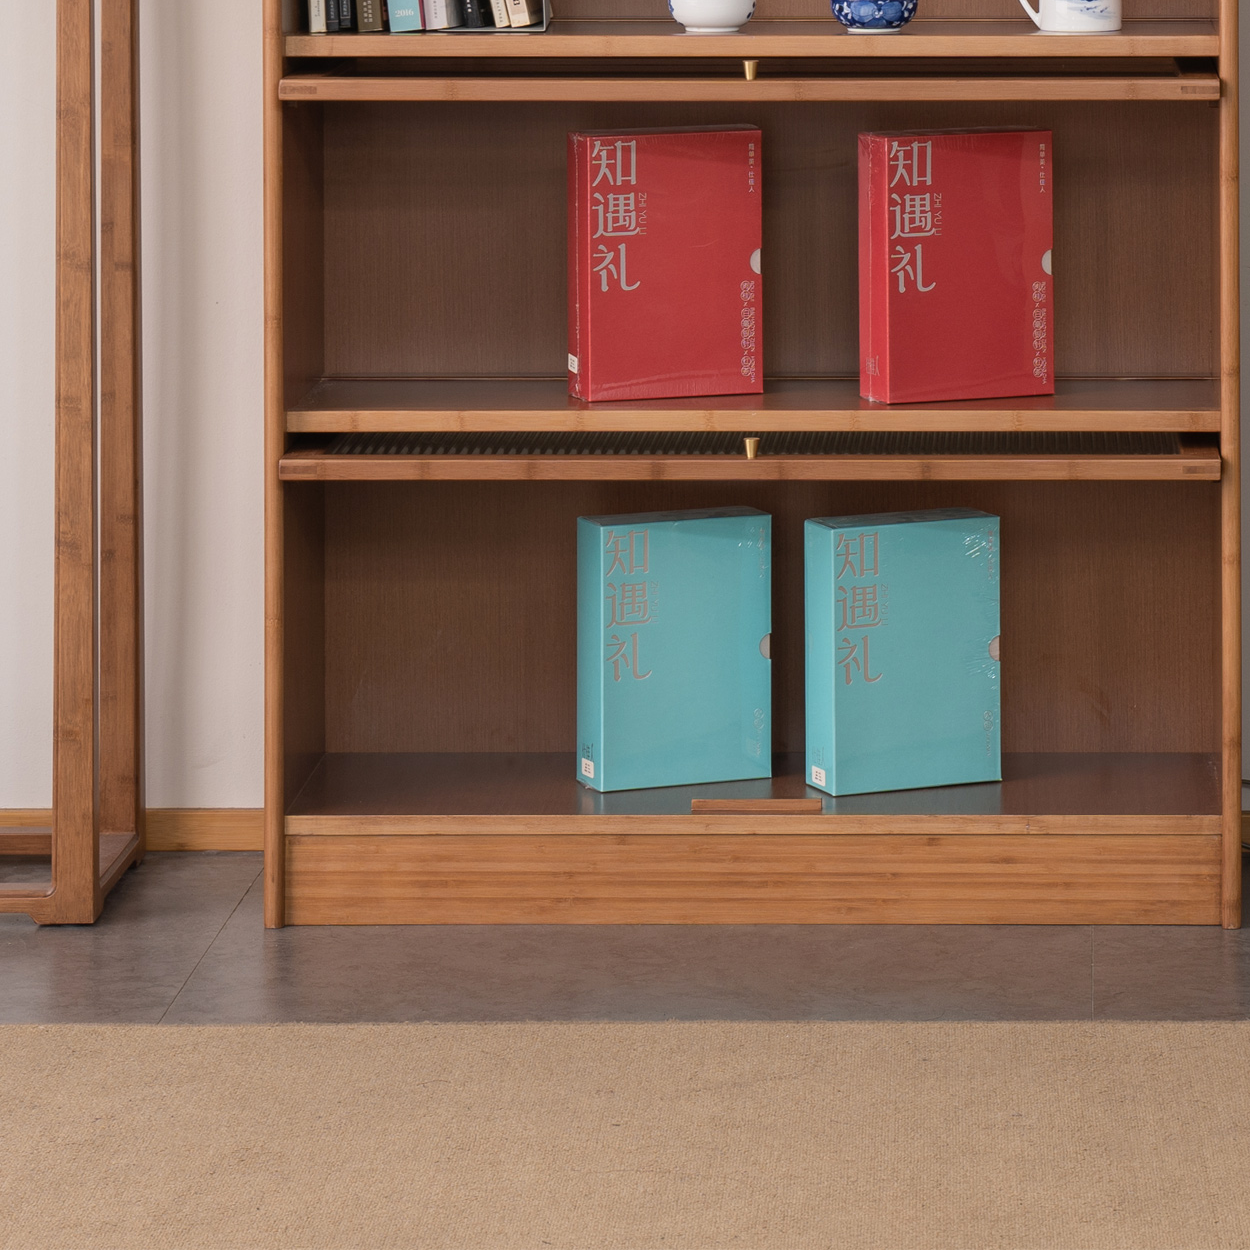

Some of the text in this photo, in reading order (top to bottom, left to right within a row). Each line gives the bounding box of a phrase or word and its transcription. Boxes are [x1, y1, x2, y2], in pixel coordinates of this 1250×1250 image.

[394, 8, 414, 18] 2016
[638, 192, 647, 208] ZHI
[933, 193, 942, 208] ZHI
[592, 140, 641, 293] 知遇礼
[638, 210, 647, 224] YU
[889, 140, 937, 294] 知遇礼
[933, 211, 942, 225] YU
[605, 528, 652, 682] 知遇礼
[836, 531, 884, 685] 知遇礼
